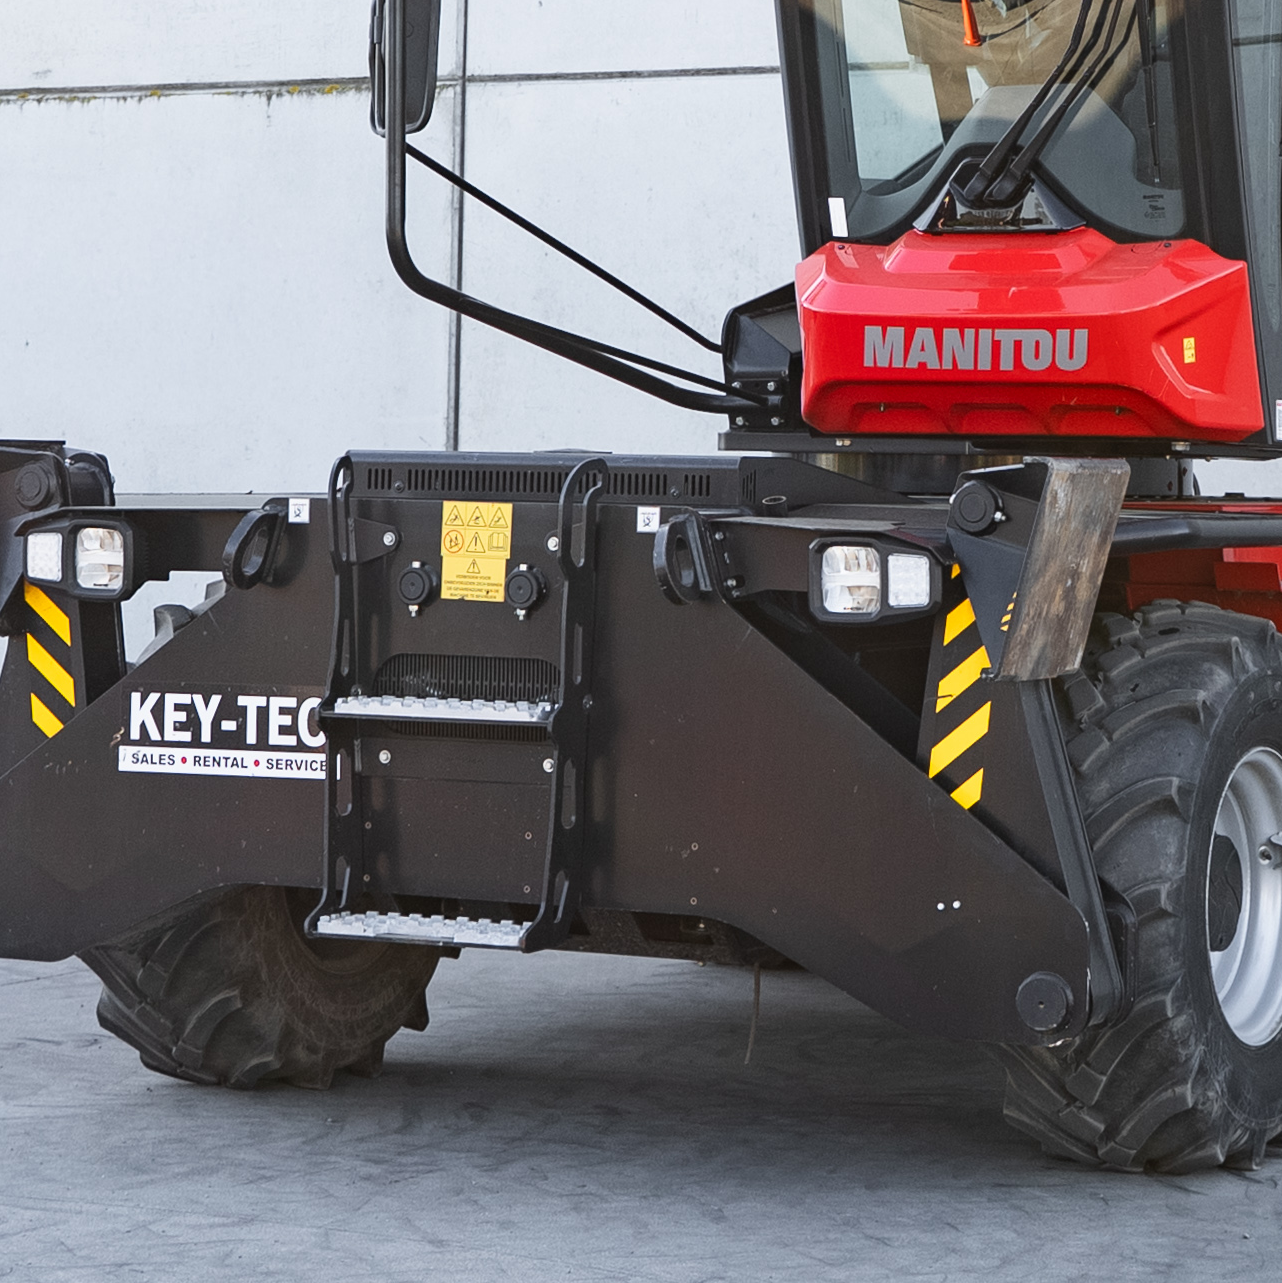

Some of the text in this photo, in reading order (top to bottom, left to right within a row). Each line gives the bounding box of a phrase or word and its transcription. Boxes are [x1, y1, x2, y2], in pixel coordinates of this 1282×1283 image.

[863, 325, 1089, 372] MANITOU
[129, 691, 328, 748] KEY-TEC
[131, 751, 176, 766] SALES
[193, 755, 248, 769] RENTAL
